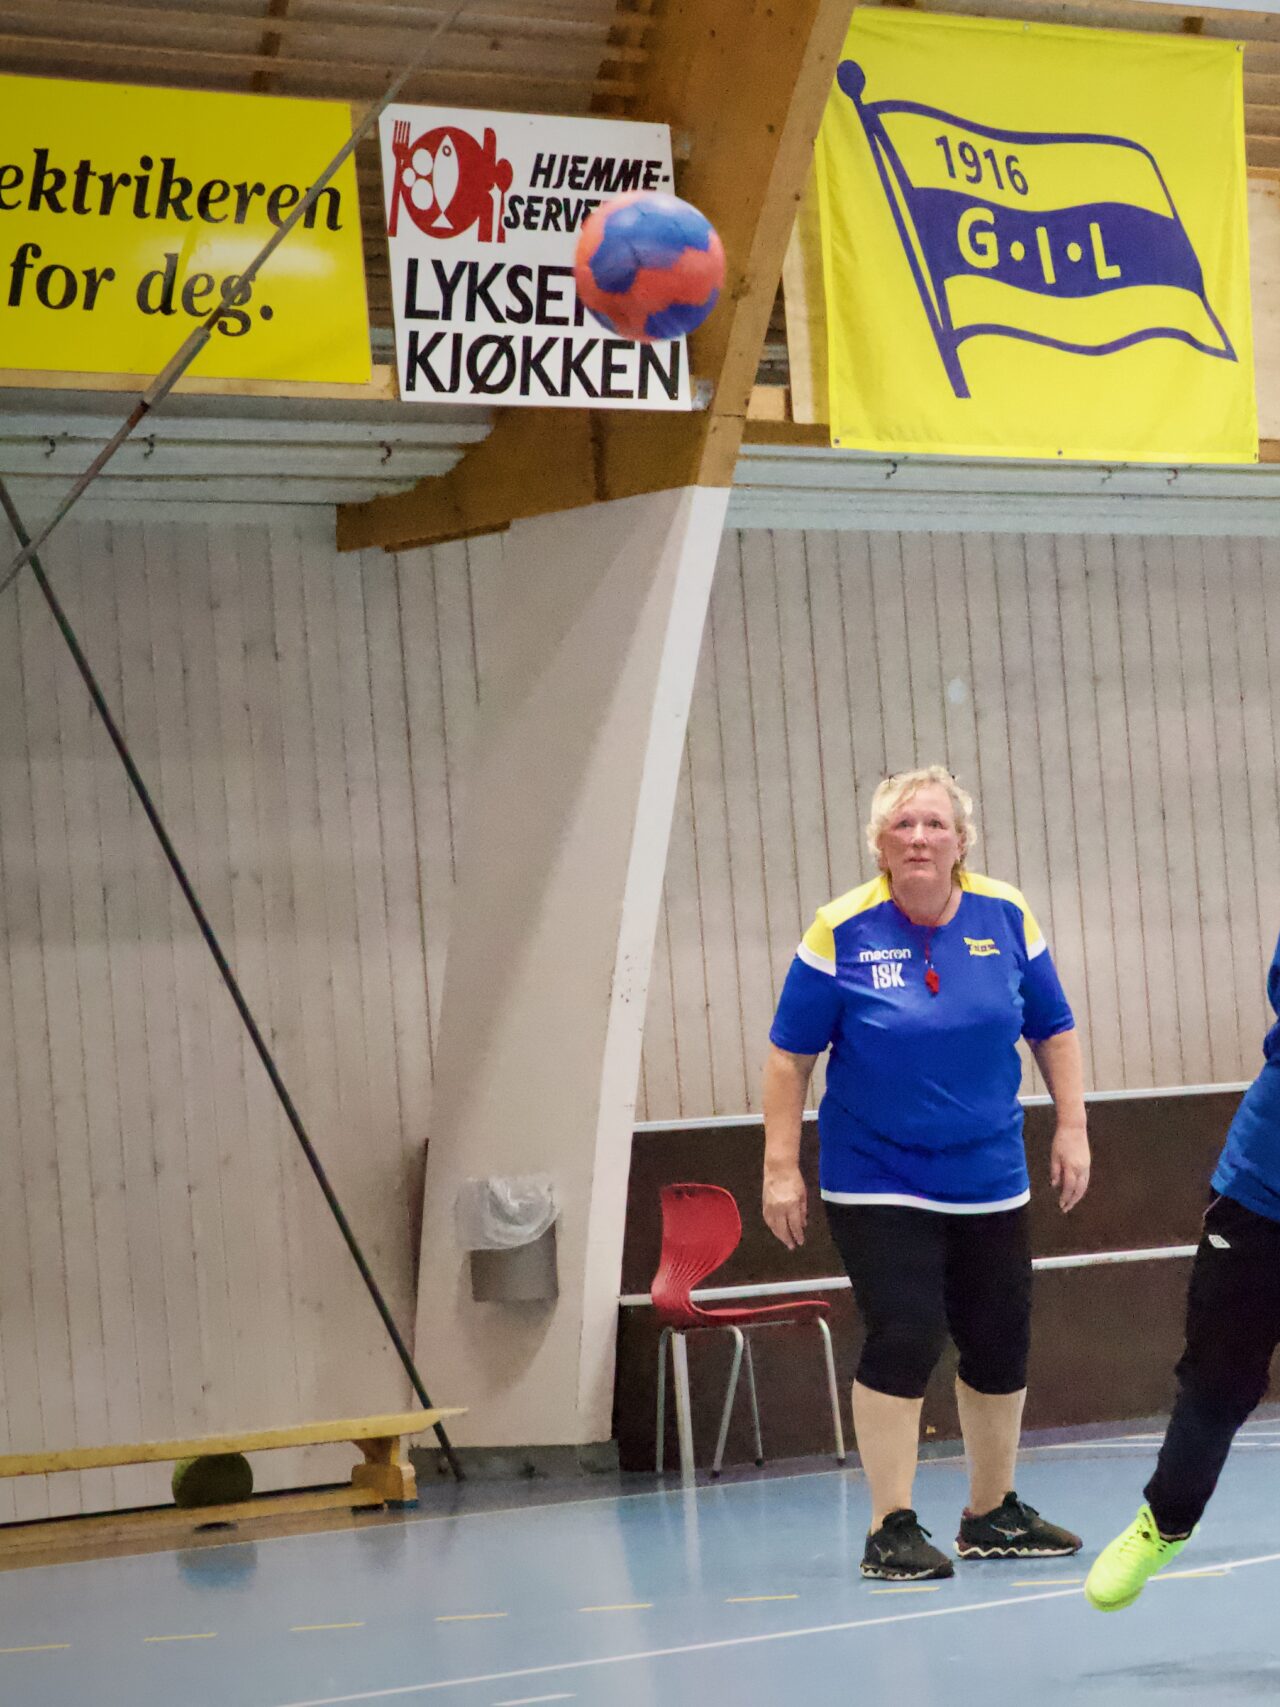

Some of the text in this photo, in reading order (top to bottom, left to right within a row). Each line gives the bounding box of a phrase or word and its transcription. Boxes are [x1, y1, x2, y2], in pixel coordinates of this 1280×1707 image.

[0, 147, 343, 232] ektrikeren
[528, 152, 671, 193] HJEMME-
[935, 134, 1029, 196] 1916
[7, 242, 274, 338] for deg.
[405, 330, 682, 401] KJØKKEN
[859, 948, 912, 963] macron
[871, 962, 906, 990] ISK
